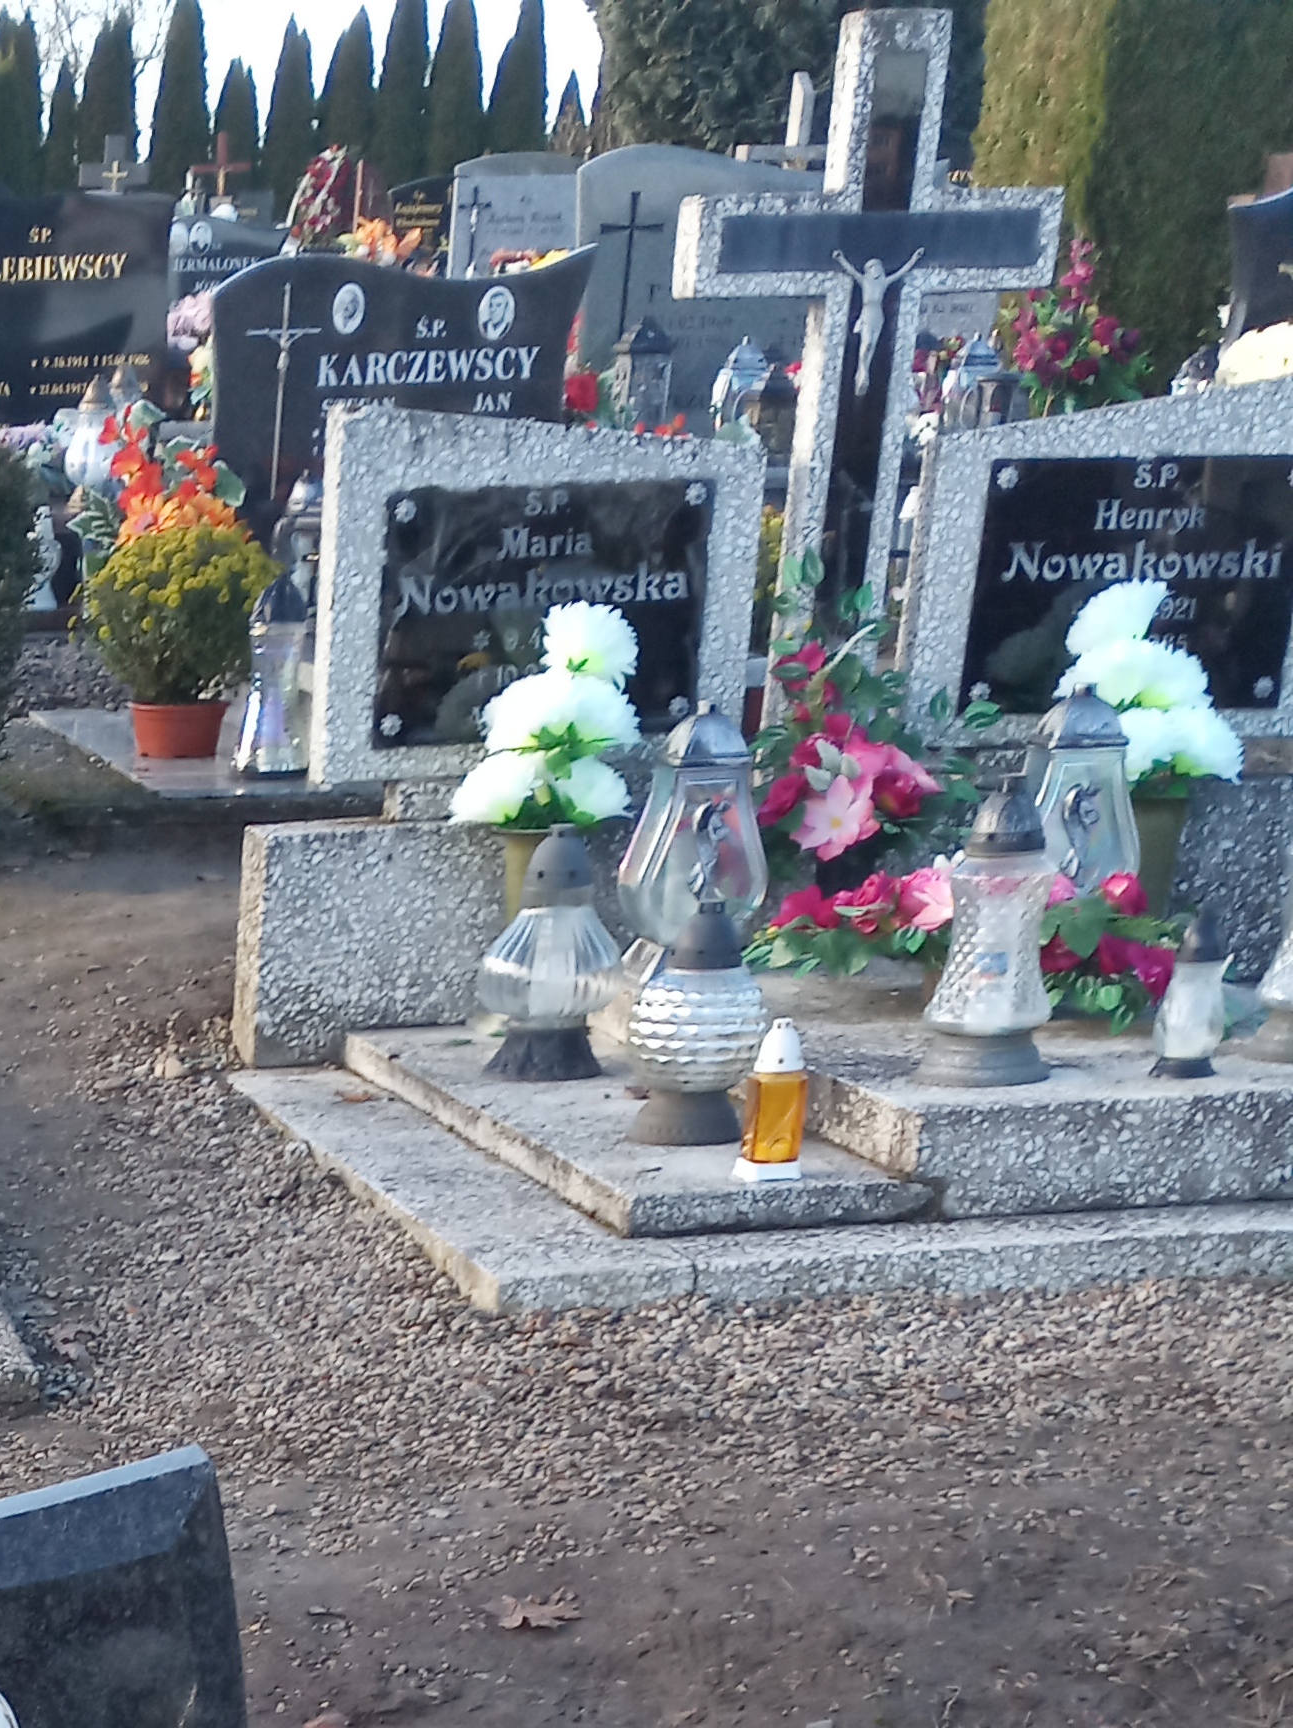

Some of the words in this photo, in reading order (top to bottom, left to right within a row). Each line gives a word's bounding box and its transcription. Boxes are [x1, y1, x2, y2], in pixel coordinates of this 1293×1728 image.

[316, 345, 542, 388] KARCZEWSCY
[471, 391, 513, 413] JAN
[1093, 498, 1208, 536] Henryk
[496, 524, 593, 561] Maria
[1000, 537, 1284, 584] Nowakowski
[392, 560, 690, 617] Nowakowska
[1154, 596, 1198, 620] 921
